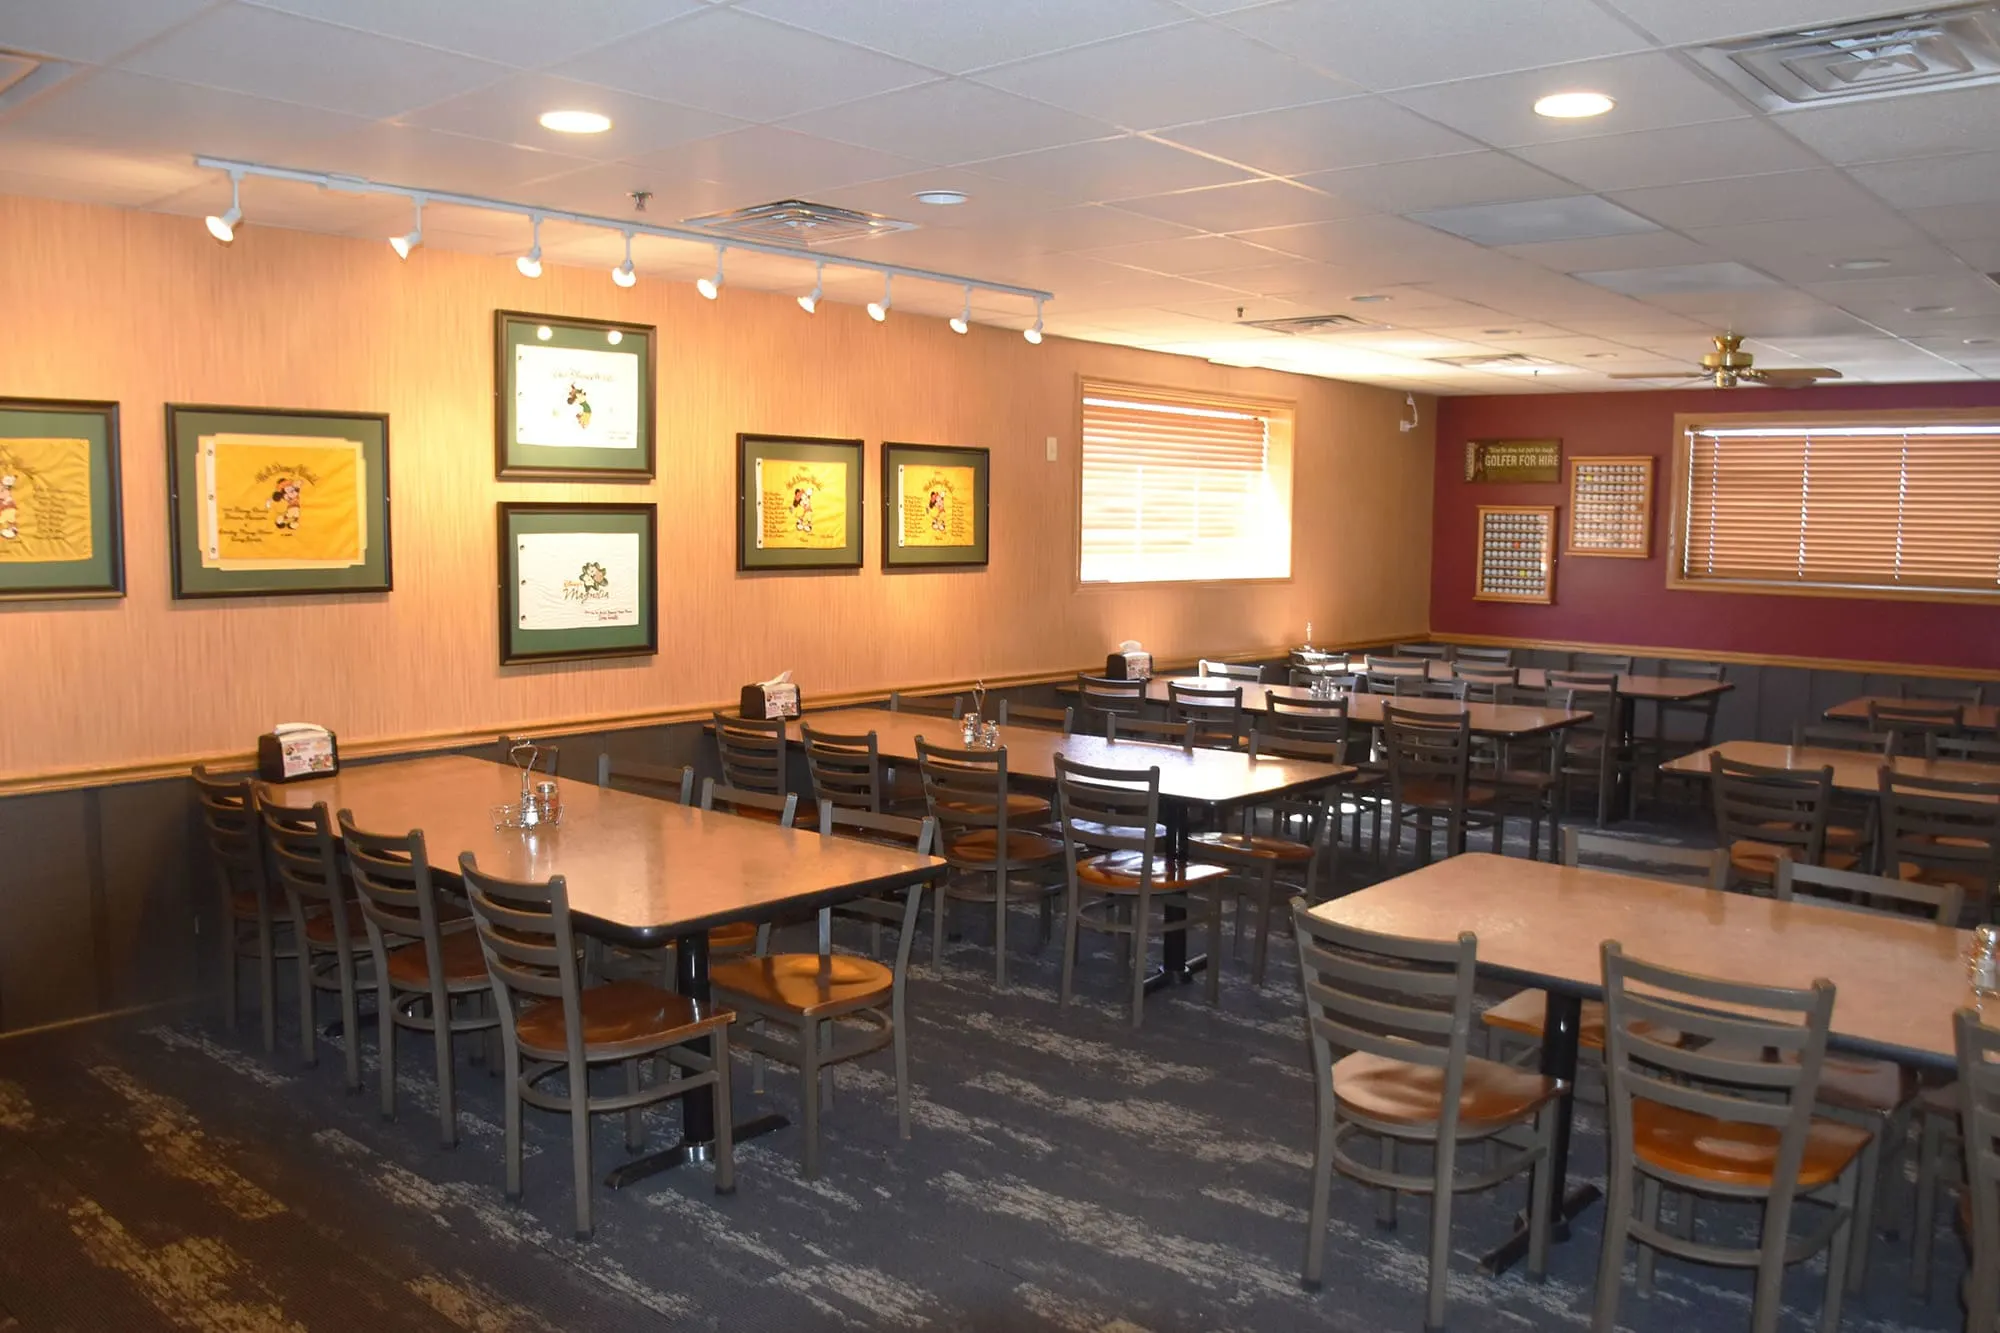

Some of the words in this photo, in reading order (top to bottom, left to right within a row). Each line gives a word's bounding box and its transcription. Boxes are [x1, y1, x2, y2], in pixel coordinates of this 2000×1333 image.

[1484, 454, 1518, 467] GOLFER
[1519, 454, 1537, 467] FOR
[1538, 454, 1560, 467] HIRE
